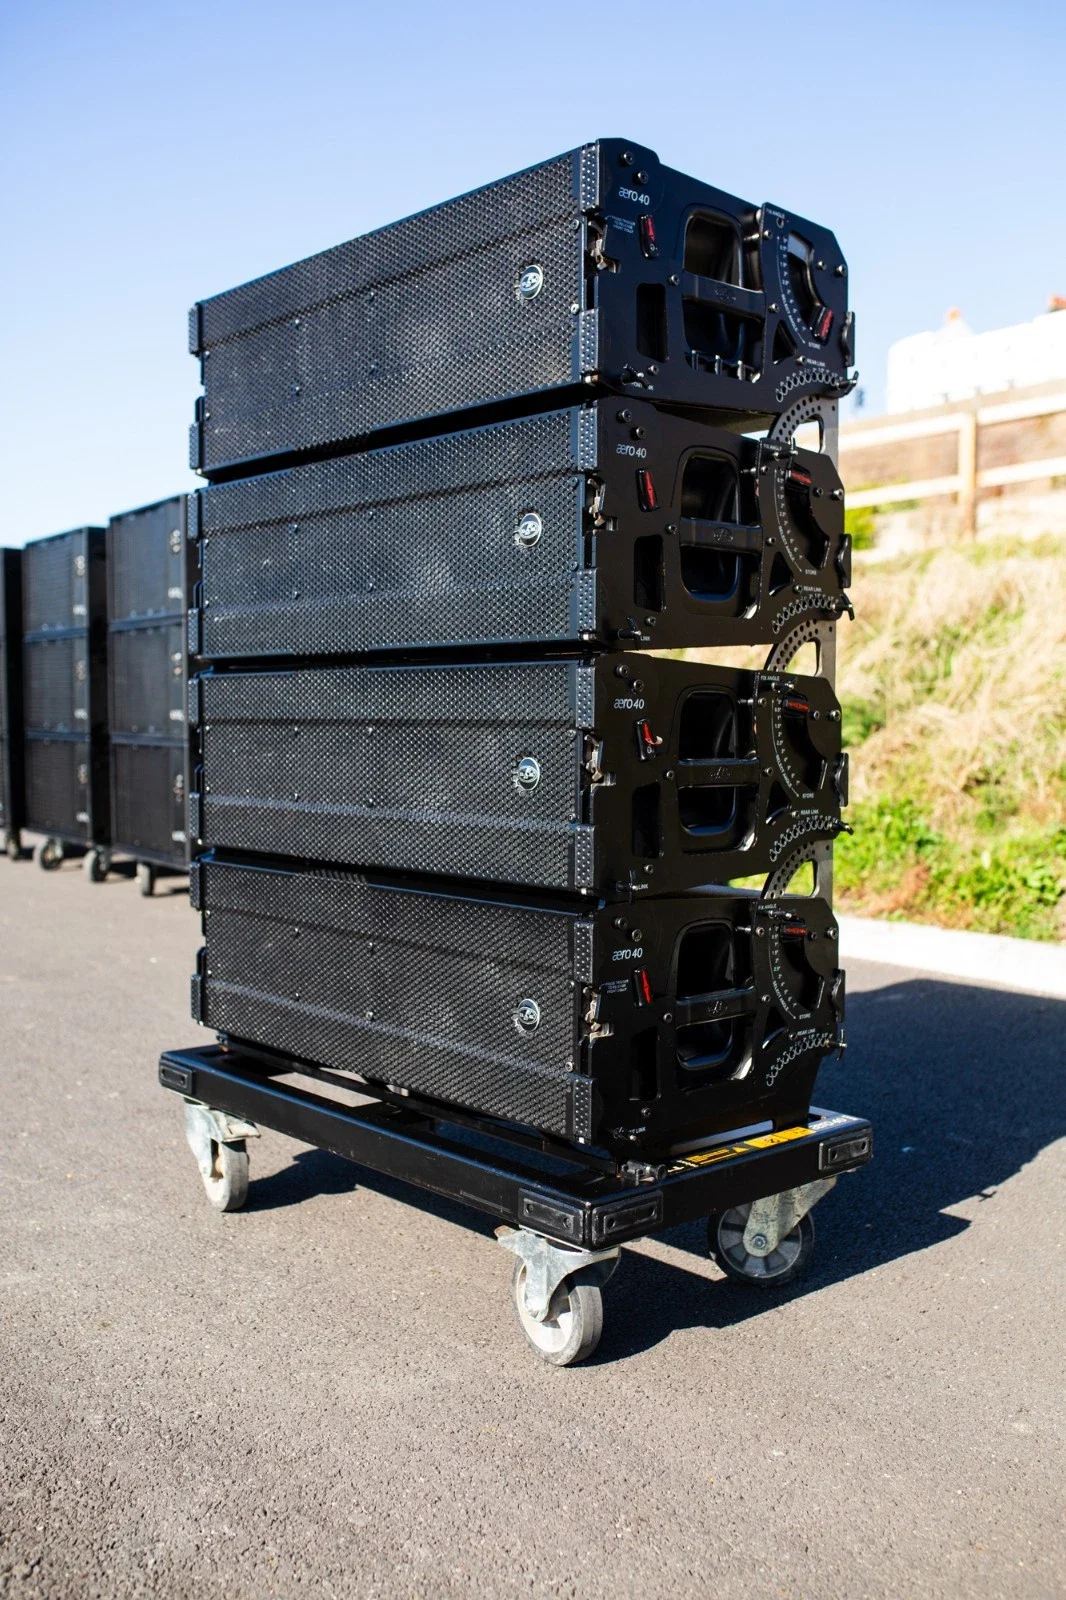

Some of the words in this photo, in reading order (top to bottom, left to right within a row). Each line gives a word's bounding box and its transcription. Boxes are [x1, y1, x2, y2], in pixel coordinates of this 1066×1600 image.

[638, 194, 650, 205] 40
[636, 448, 647, 458] 40
[633, 698, 645, 709] 40
[632, 947, 643, 959] 40
